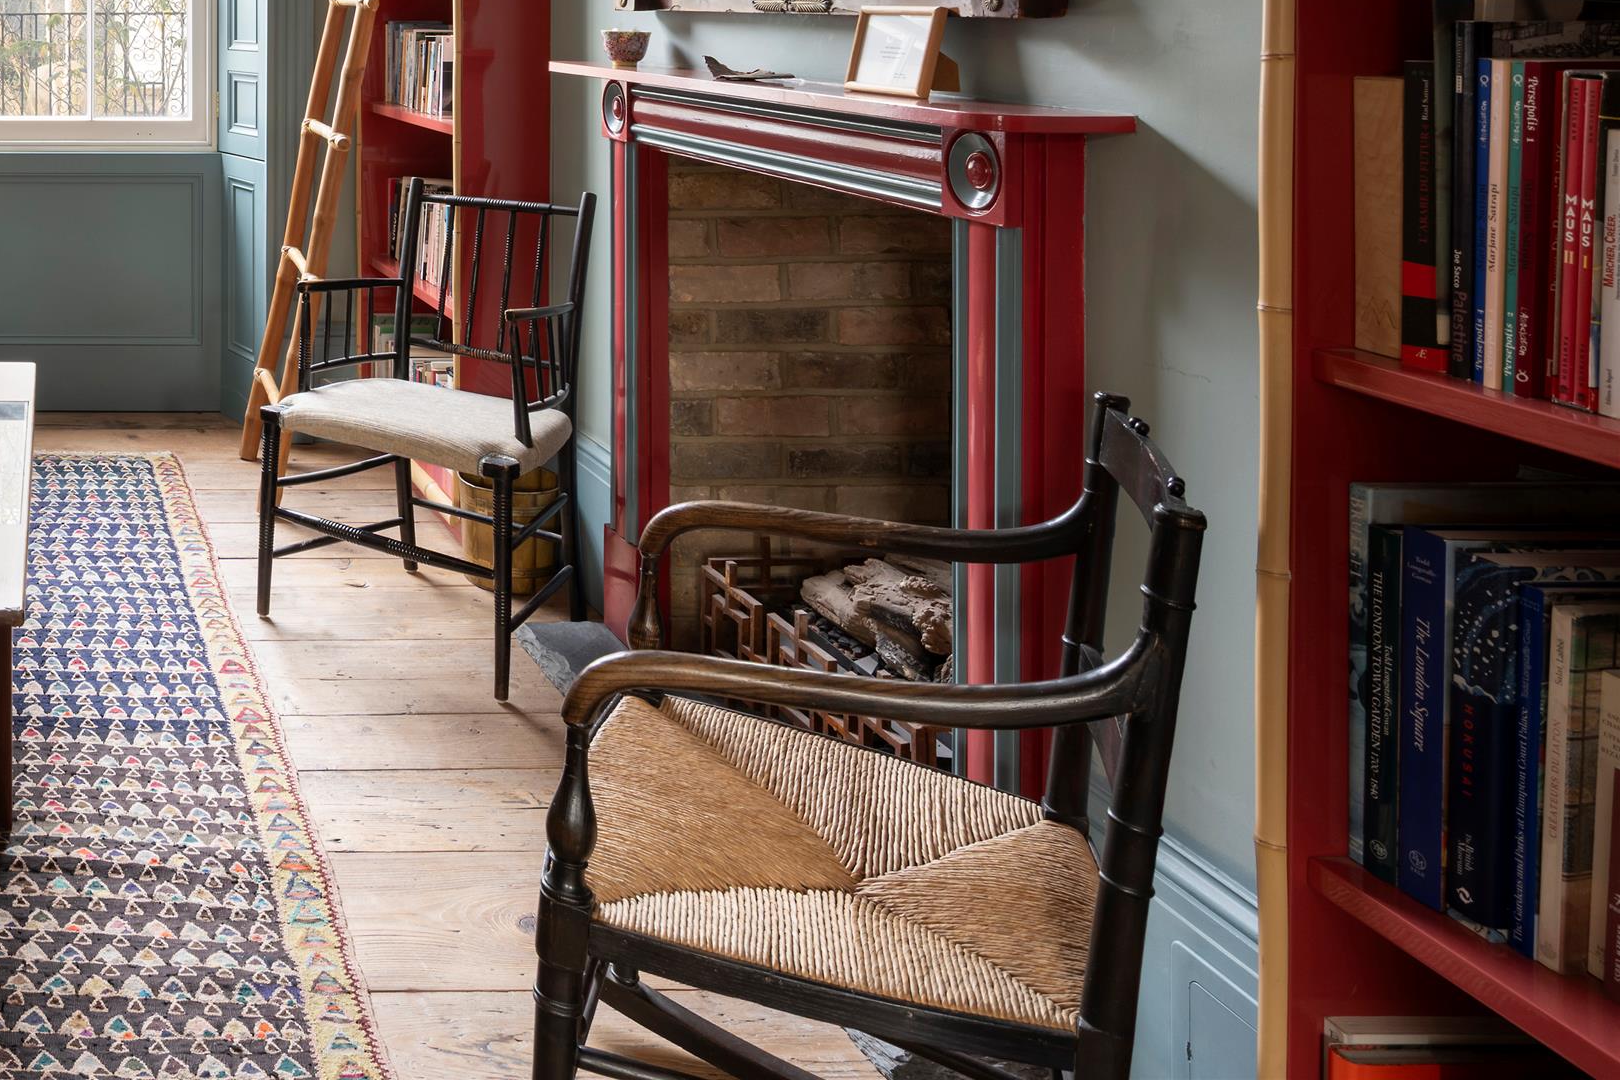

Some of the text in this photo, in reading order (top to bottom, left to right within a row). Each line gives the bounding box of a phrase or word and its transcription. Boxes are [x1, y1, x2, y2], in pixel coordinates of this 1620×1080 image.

[1524, 76, 1539, 131] Persepolis
[1419, 174, 1430, 245] L'ARABE DU
[1488, 183, 1500, 273] Marjane Satrapi
[1507, 185, 1520, 276] Marjane Satrapi
[1564, 194, 1578, 243] MAUS
[1580, 198, 1594, 270] MAUS I
[1601, 244, 1616, 288] MARCHER,
[1452, 249, 1468, 362] Joe Sacco Palestine
[1475, 318, 1485, 370] Persepolis
[1503, 323, 1516, 377] Persepolis
[1370, 570, 1384, 750] THE LONDON TOWN GARDEN
[1383, 644, 1393, 665] Todd
[1409, 615, 1431, 752] The London Square
[1461, 703, 1476, 800] HOKUSAI
[1550, 758, 1561, 772] DU
[1551, 720, 1562, 756] JAPON
[1513, 705, 1529, 943] The Gardens and Parks at Hampton Court Palace
[1463, 844, 1474, 872] British
